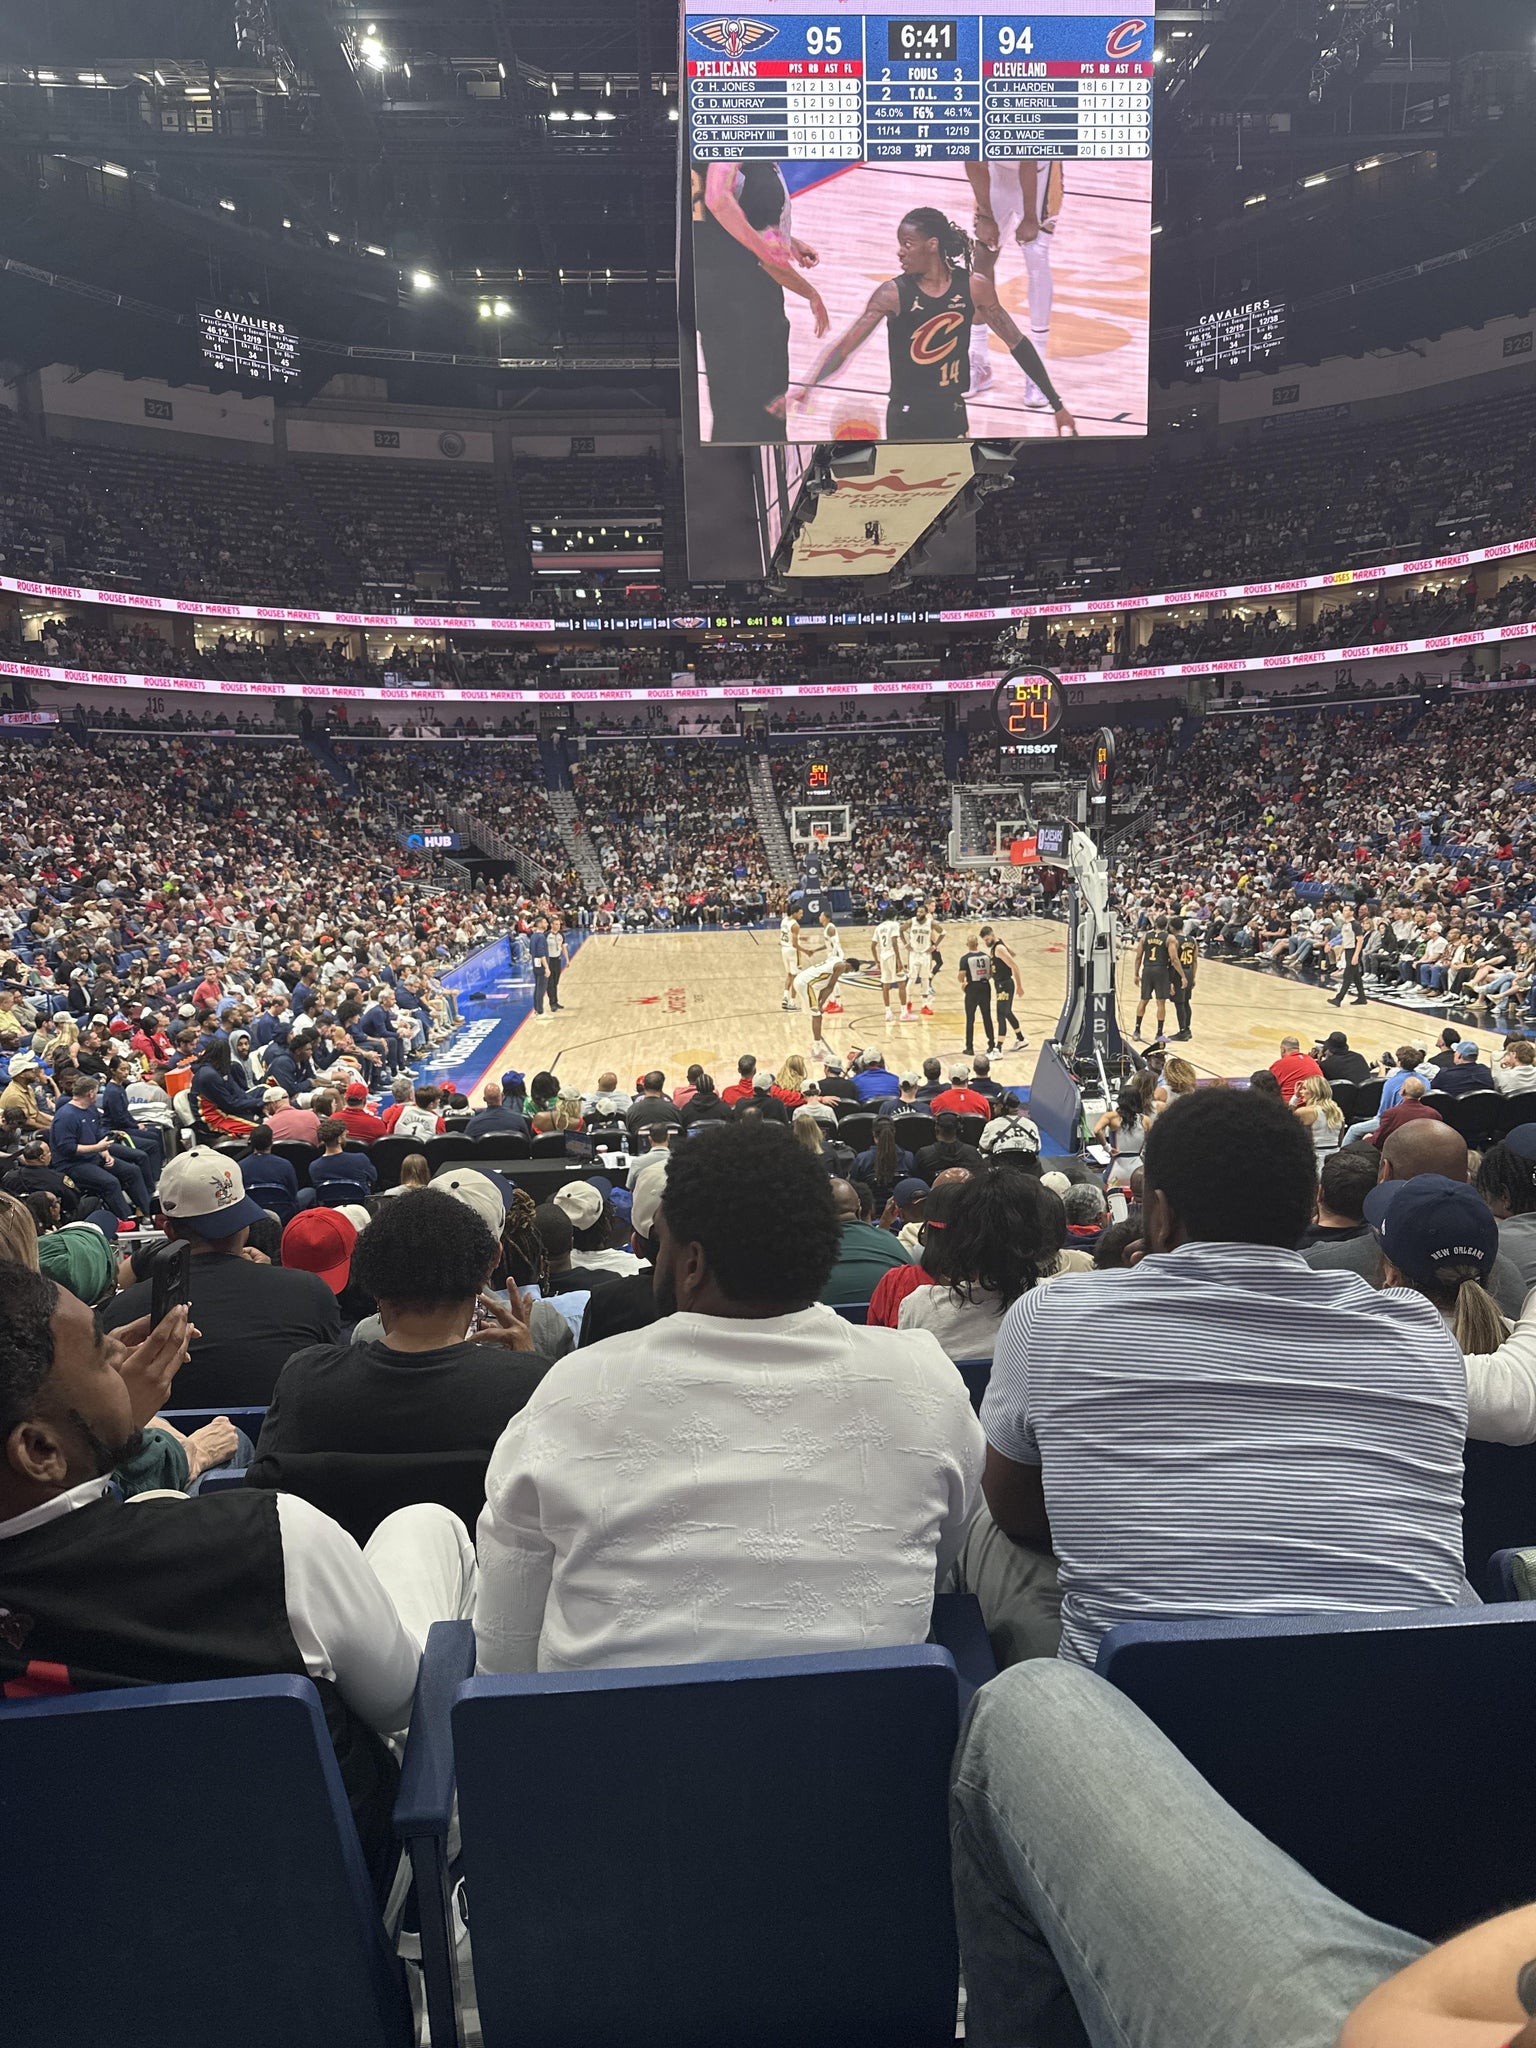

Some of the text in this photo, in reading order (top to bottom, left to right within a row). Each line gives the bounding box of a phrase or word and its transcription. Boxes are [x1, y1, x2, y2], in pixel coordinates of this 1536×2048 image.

[806, 26, 842, 55] 95
[901, 25, 950, 48] 6:41
[999, 26, 1033, 54] 94
[1106, 19, 1147, 58] C
[696, 61, 852, 77] PELICANS PTS RB AST FL
[881, 68, 963, 81] 2 FOULS 3
[993, 62, 1143, 77] CLEVELAND PTS RB AST FL
[697, 82, 756, 92] 2 H. JONES
[992, 83, 1055, 92] 1 J. HARDEN
[881, 87, 963, 101] 2 T.O.L. 3
[697, 99, 765, 109] 5 D. MURRAY
[991, 99, 1057, 108] 5 S. MERRILL
[696, 115, 748, 124] 21 Y. MISSI
[875, 107, 973, 119] 45.0% FG% 46.1%
[989, 114, 1041, 123] 14 K. ELLIS
[696, 131, 775, 140] 25 T. MURPHY III
[877, 126, 970, 138] 11/14 FT 12/19
[989, 130, 1045, 139] 32 D. WADE
[699, 147, 744, 156] 41 S. BEY
[877, 145, 970, 157] 12/38 3PT 12/38
[989, 146, 1064, 155] 45 D. MITCHELL
[1200, 300, 1270, 325] CAVALIERS
[214, 309, 285, 333] CAVALIERS
[910, 311, 964, 365] C
[1505, 336, 1533, 352] 328
[939, 360, 960, 387] 14
[1275, 388, 1298, 401] 327
[147, 401, 170, 417] 321
[376, 434, 398, 445] 322
[573, 440, 594, 450] 323
[1403, 553, 1470, 573] ROUSES MARKETS
[1323, 568, 1386, 584] ROUSES MARKETS
[17, 581, 82, 599] ROUSES MARKETS
[1164, 589, 1227, 603] ROUSES MARKETS
[99, 591, 162, 608] ROUSES MARKETS
[1087, 598, 1149, 611] ROUSES MARKETS
[177, 601, 241, 616] ROUSES MARKETS
[336, 613, 398, 626] ROUSES MARKETS
[715, 618, 728, 627] 95
[747, 616, 763, 626] 6:41
[771, 616, 783, 626] 94
[794, 615, 826, 625] CAVALIERS
[1342, 643, 1409, 659] ROUSES MARKETS
[1264, 652, 1326, 666] ROUSES MARKETS
[65, 670, 127, 684] ROUSES MARKETS
[1102, 668, 1165, 680] ROUSES MARKETS
[1334, 669, 1352, 683] 121
[144, 677, 206, 690] ROUSES MARKETS
[798, 684, 858, 694] ROUSES MARKETS
[302, 686, 365, 697] ROUSES MARKETS
[571, 689, 632, 700] ROUSES MARKETS
[1016, 682, 1053, 701] 6:41
[147, 697, 164, 713] 116
[840, 700, 856, 713] 119
[1009, 701, 1048, 732] 24
[1016, 745, 1058, 754] TISSOT
[810, 773, 827, 786] 24
[425, 836, 452, 847] HUB
[1045, 829, 1063, 842] CAESARS
[808, 900, 820, 913] G
[916, 935, 924, 944] 41
[1149, 946, 1156, 960] 1
[1181, 950, 1193, 965] 45
[976, 958, 985, 968] 43
[412, 1125, 418, 1135] 1
[1430, 1246, 1485, 1260] NEW ORLEANS
